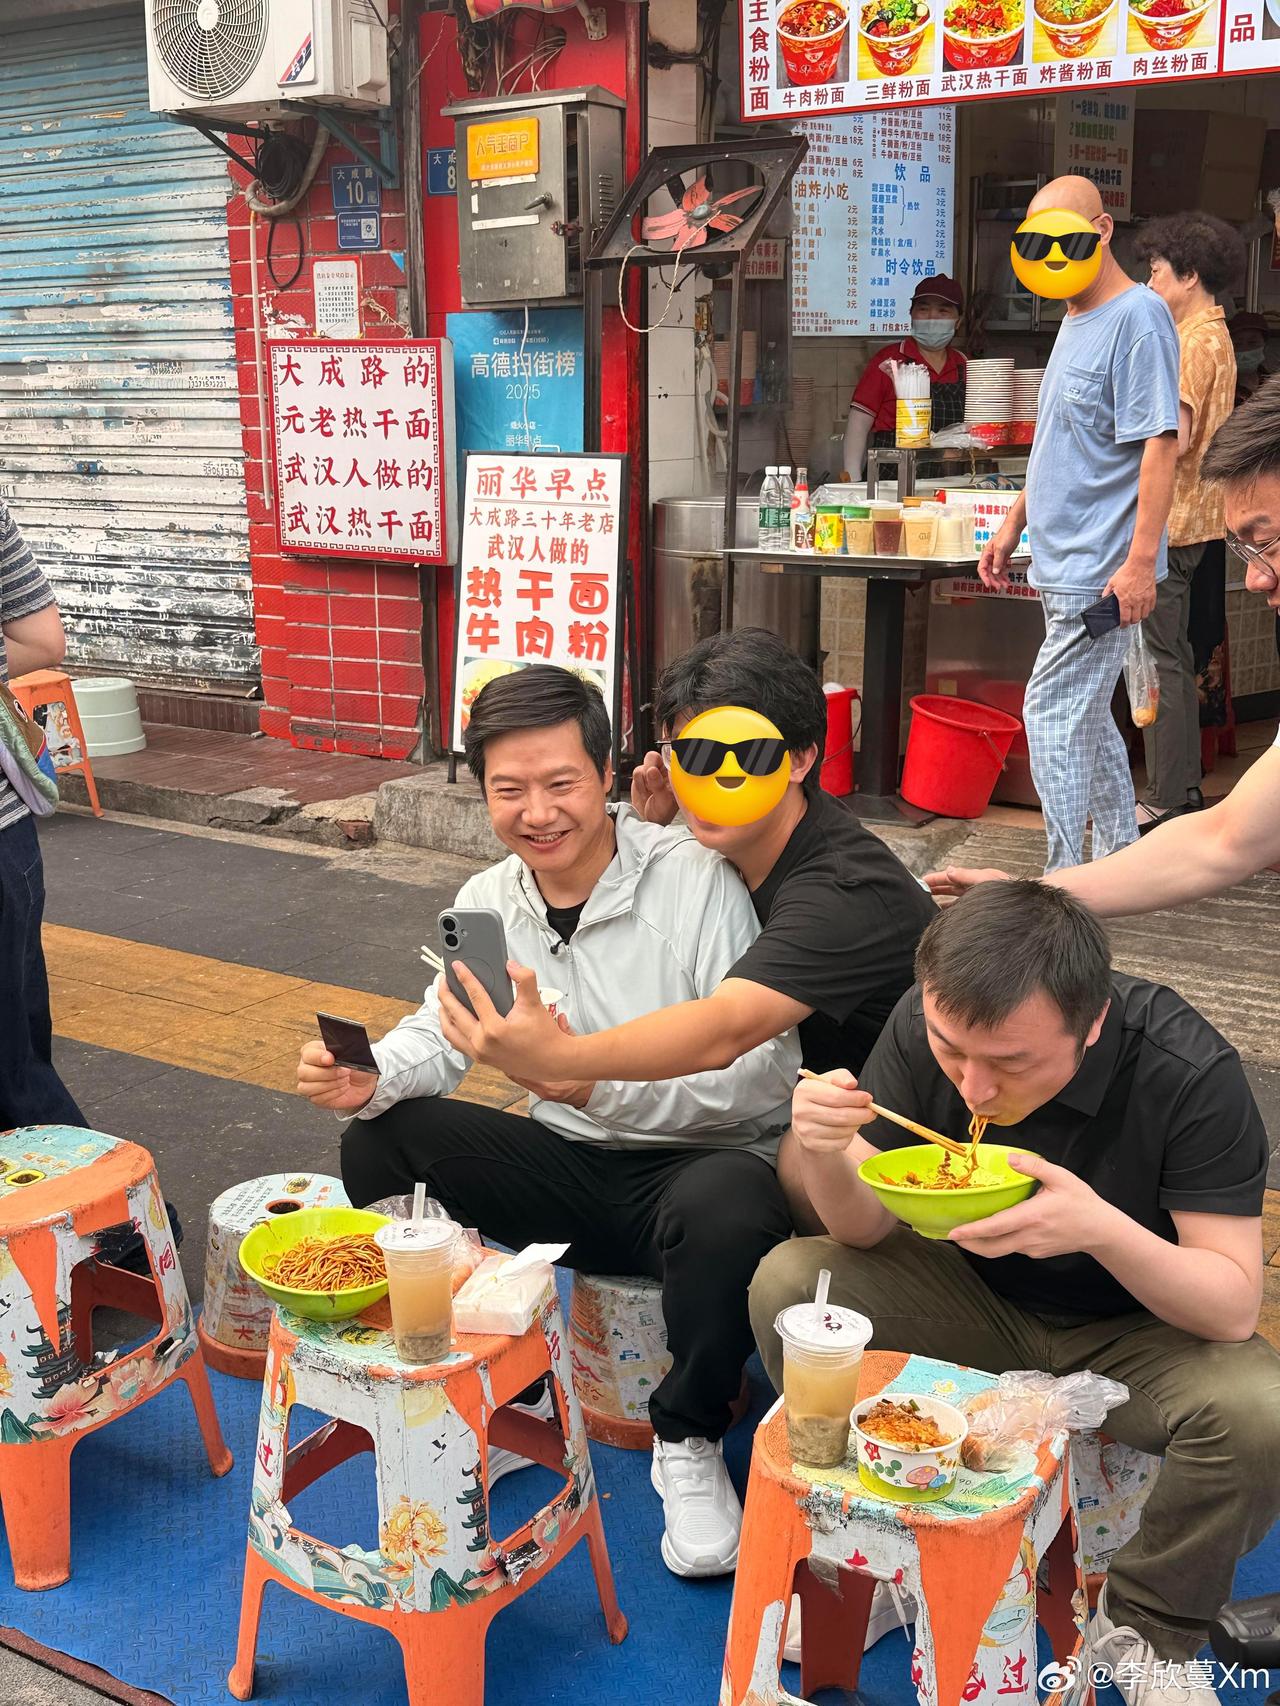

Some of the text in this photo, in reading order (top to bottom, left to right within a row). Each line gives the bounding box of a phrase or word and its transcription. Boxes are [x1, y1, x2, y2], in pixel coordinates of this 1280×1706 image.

[748, 0, 771, 112] 主食粉面
[782, 52, 1209, 109] 牛肉粉面 三鲜粉面 武汉热干面 炸酱粉面 肉丝粉面
[938, 112, 952, 122] 11元
[938, 123, 952, 132] 10元
[849, 136, 864, 146] 18元
[938, 133, 952, 143] 18元
[895, 163, 931, 183] 饮品
[346, 180, 364, 205] 10
[794, 180, 849, 200] 油炸小吃
[936, 187, 946, 196] 2元
[847, 205, 858, 214] 2元
[885, 258, 936, 276] 时令饮品
[278, 354, 431, 389] 大成路的
[470, 351, 577, 378] 高德扫街榜
[505, 383, 541, 400] 2025
[281, 405, 431, 440] 元老热干面
[284, 452, 433, 491] 武汉人做的
[476, 465, 610, 502] 丽华早点
[286, 501, 433, 542] 武汉热干面
[468, 506, 615, 535] 大成路三十年老店
[487, 533, 590, 565] 武汉人做的
[466, 566, 610, 616] 热干面
[466, 612, 611, 662] 牛肉粉
